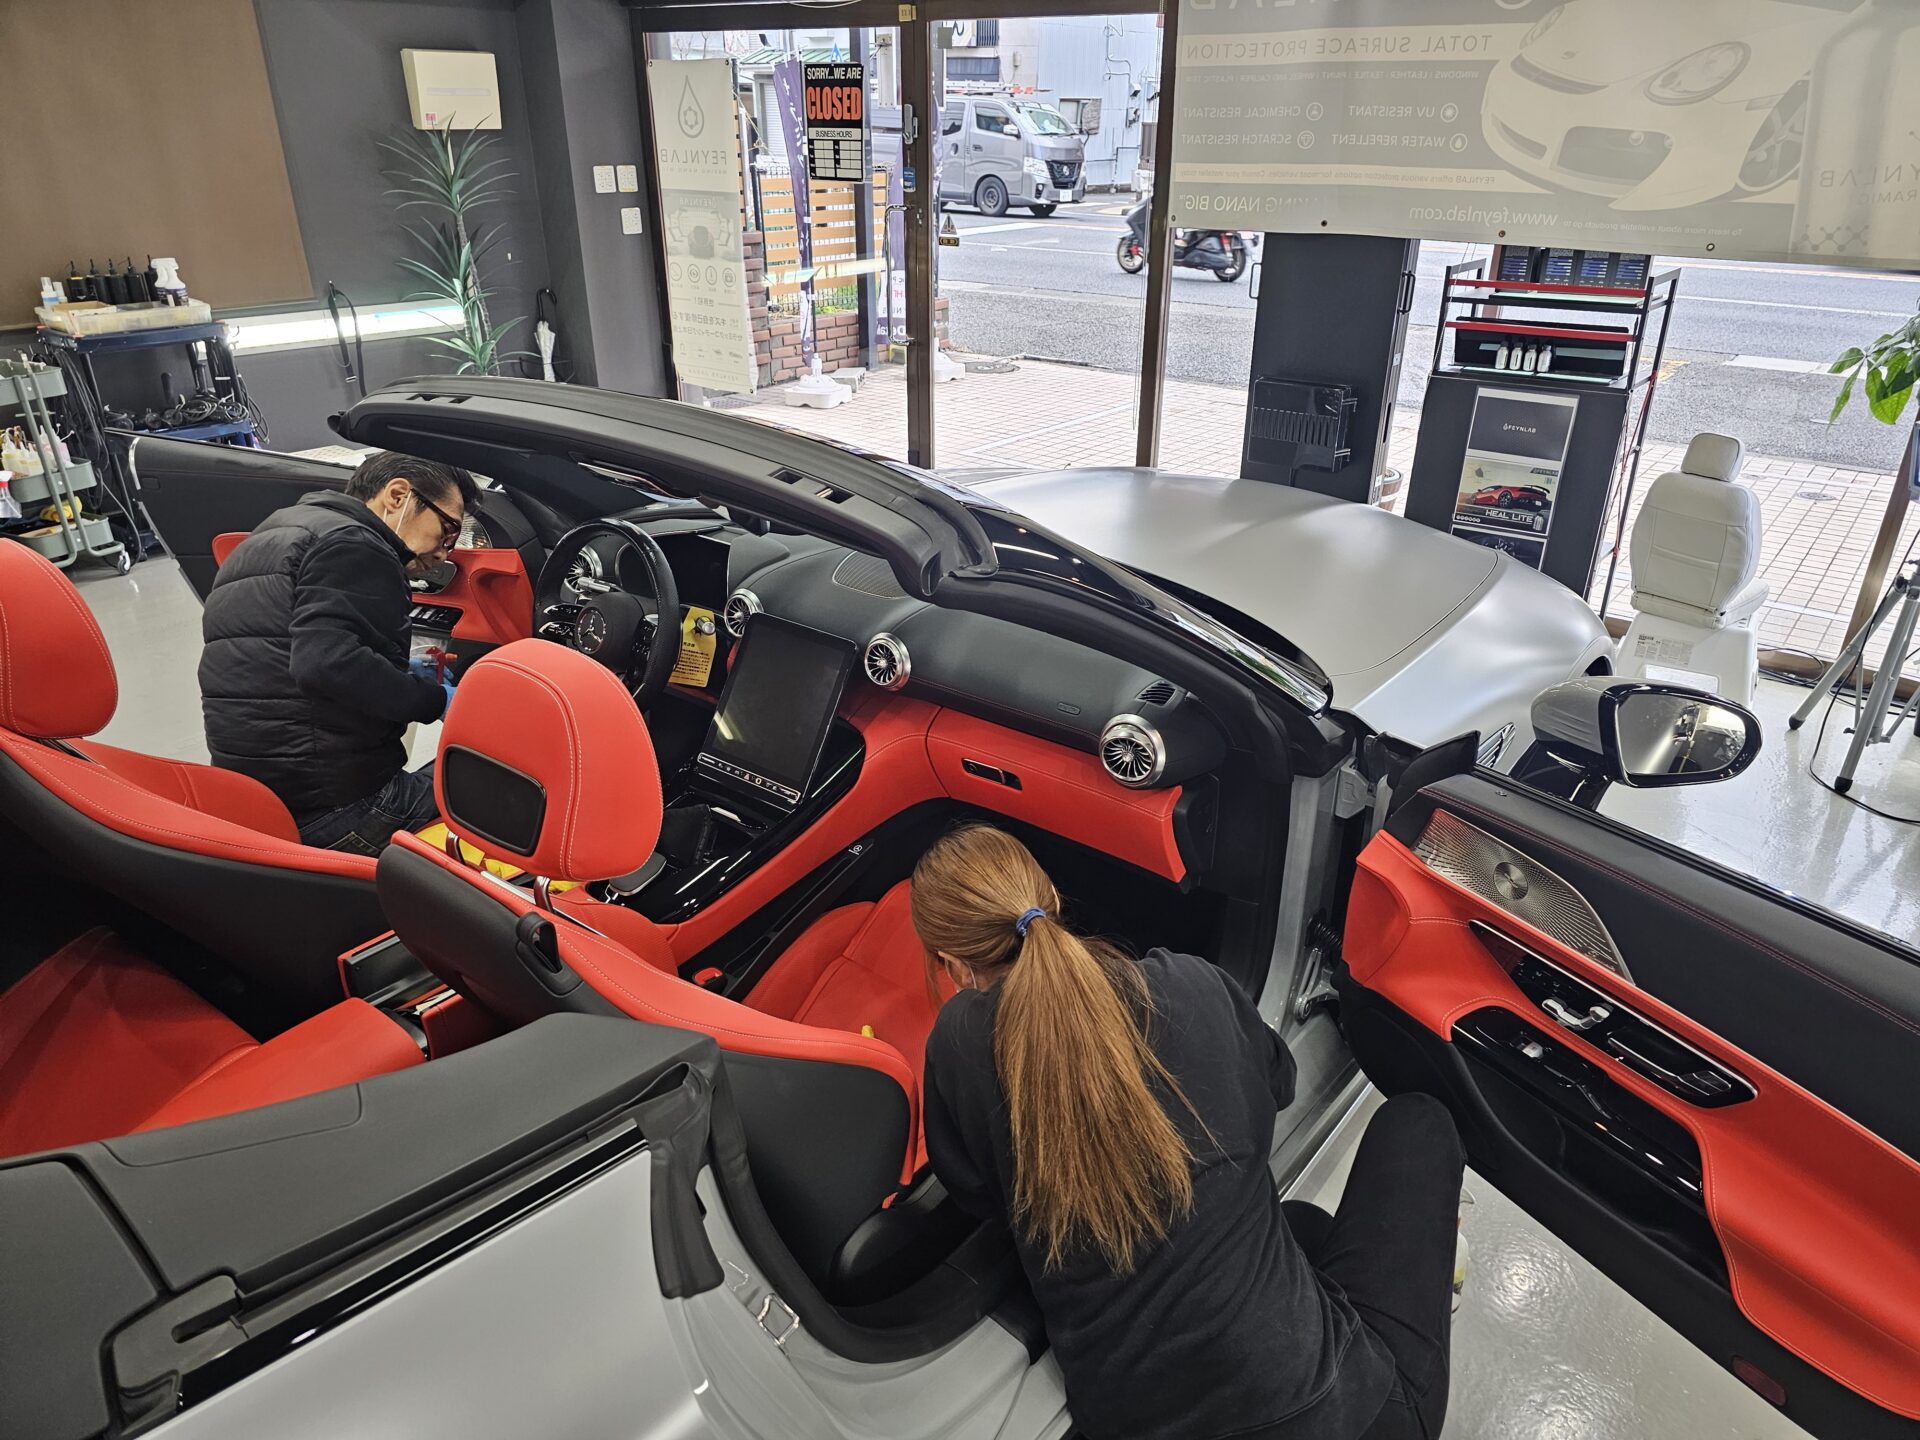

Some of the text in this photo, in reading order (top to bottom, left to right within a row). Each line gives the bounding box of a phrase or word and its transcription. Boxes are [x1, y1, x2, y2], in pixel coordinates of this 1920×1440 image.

[846, 67, 862, 80] ARE
[807, 86, 862, 121] CLOSED
[1508, 424, 1537, 434] FEYNLAB
[1485, 509, 1534, 524] HEAL LITE
